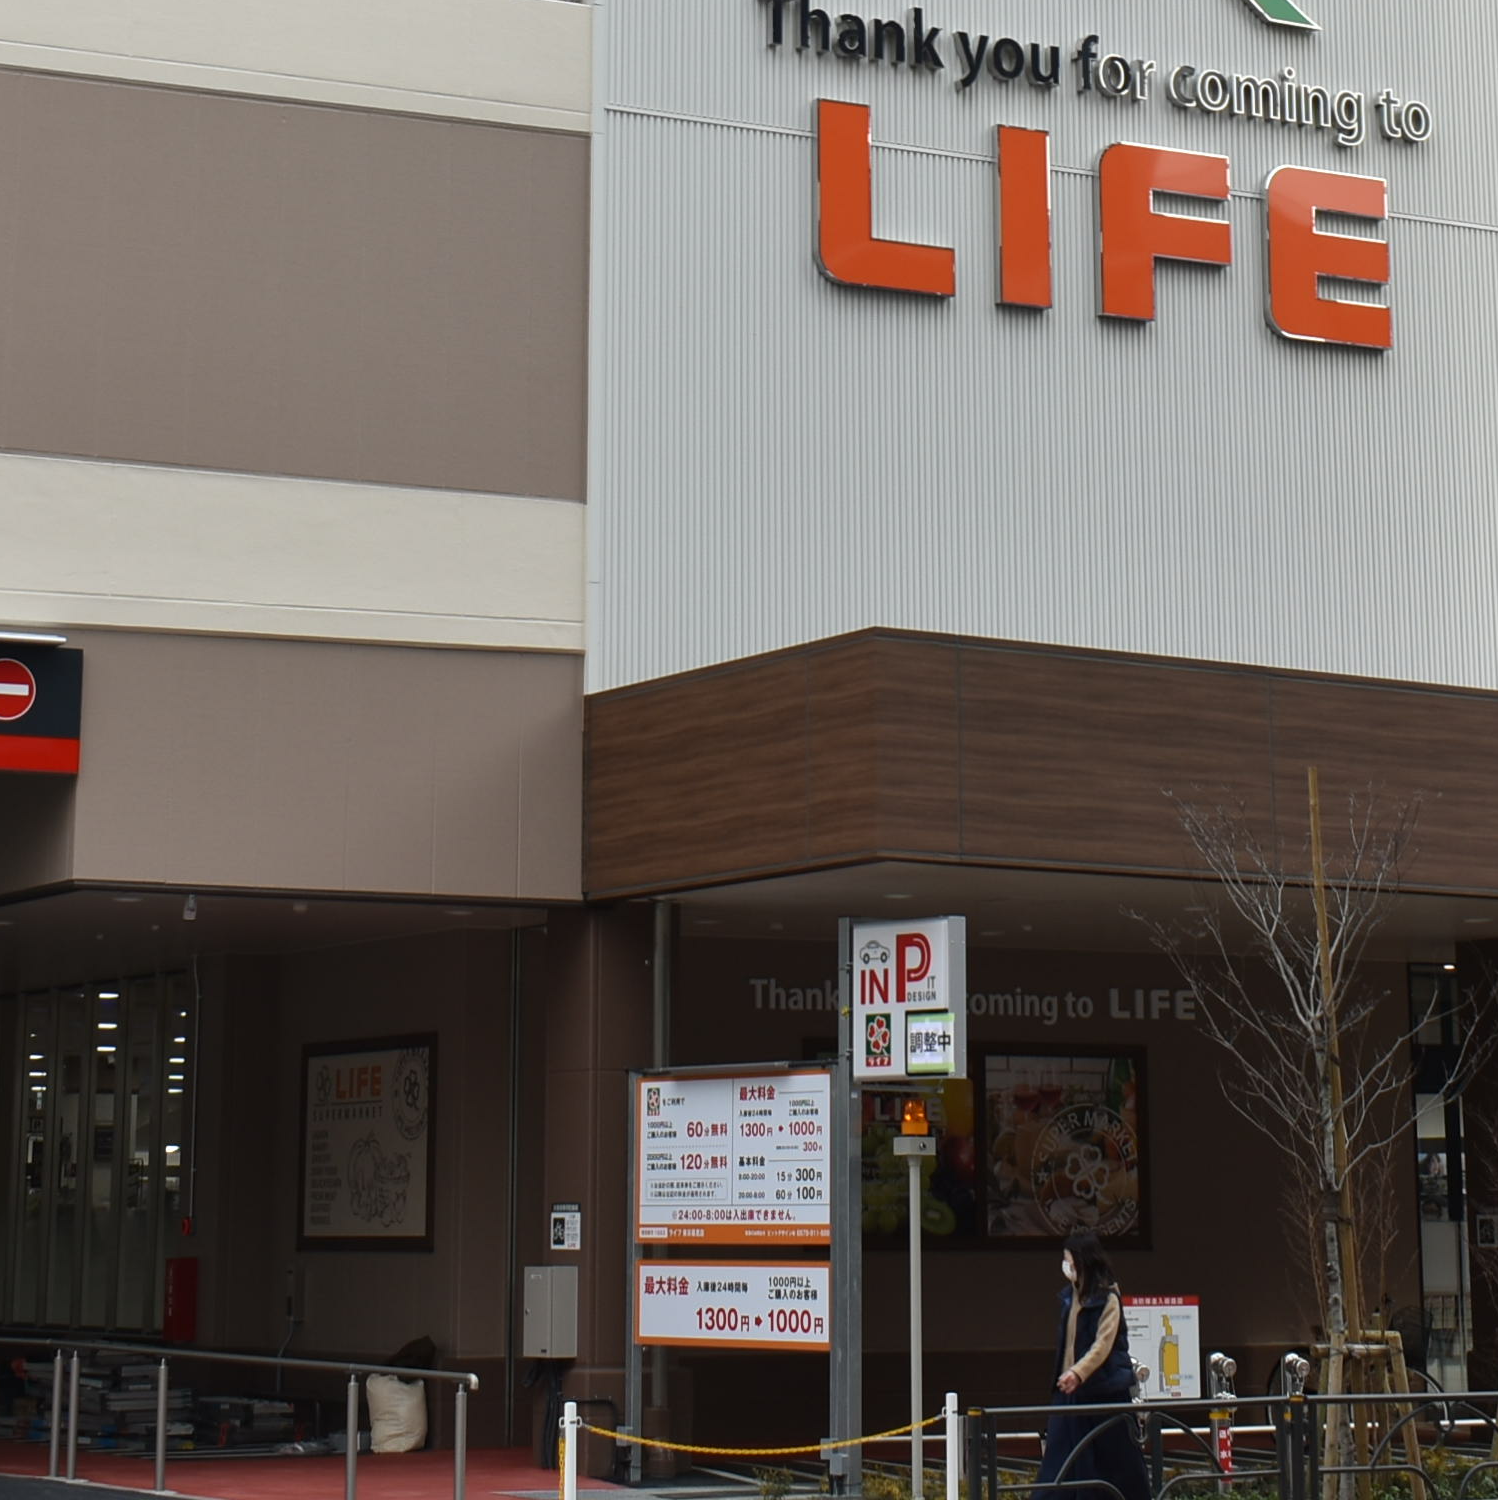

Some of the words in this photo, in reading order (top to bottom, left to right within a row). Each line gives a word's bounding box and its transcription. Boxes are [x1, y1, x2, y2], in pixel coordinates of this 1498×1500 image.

[954, 34, 1061, 90] you
[1072, 34, 1157, 101] for
[1168, 67, 1366, 147] coming
[1376, 88, 1432, 143] to
[815, 98, 1394, 351] LIFE
[860, 968, 889, 1005] IN
[907, 990, 937, 1002] DESIGN
[749, 979, 839, 1011] Thank
[967, 987, 1058, 1025] oming
[1065, 991, 1094, 1018] to
[1109, 987, 1197, 1020] LIFE
[910, 1030, 951, 1053] 調整中
[335, 1065, 382, 1099] LIFE
[740, 1085, 775, 1101] 最大料金
[874, 1096, 942, 1121] LIE
[740, 1122, 773, 1137] 1300円
[789, 1121, 822, 1136] 1000円
[644, 1276, 690, 1296] 最大料金
[768, 1276, 811, 1288] 1000円以上
[767, 1289, 818, 1301] ご購入のお客様
[696, 1307, 750, 1332] 1300円
[767, 1309, 824, 1335] 1000円
